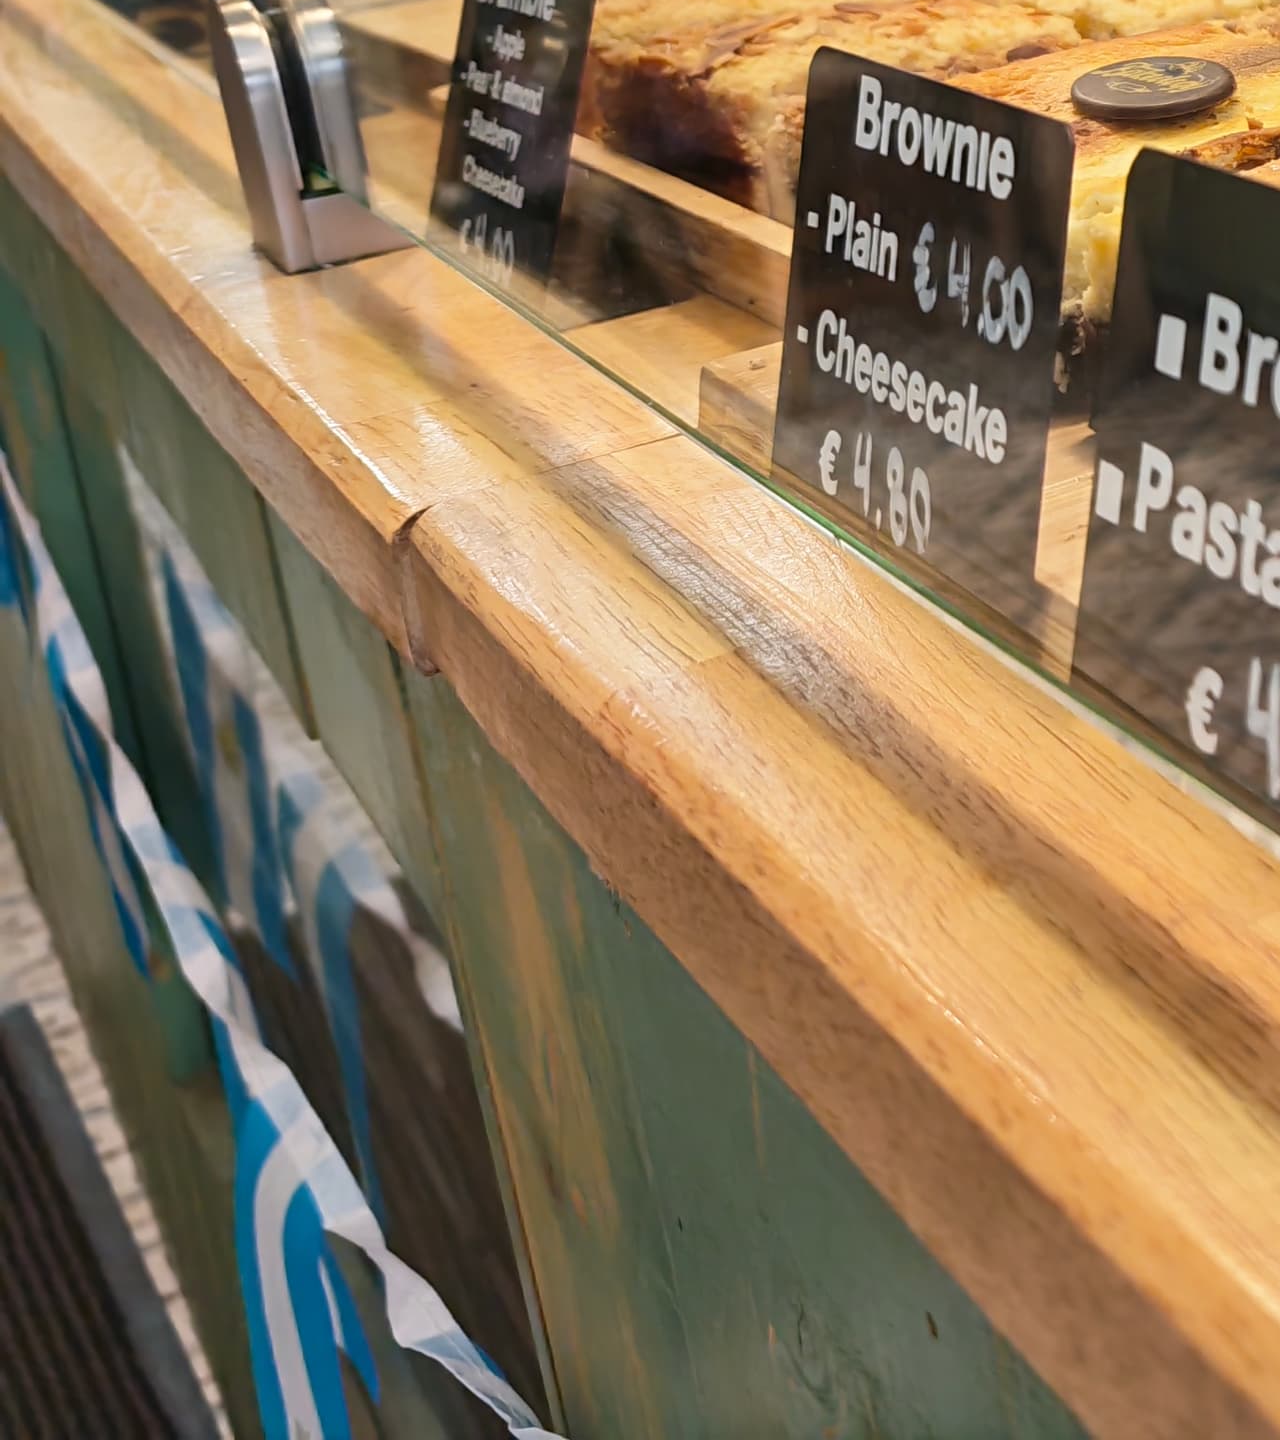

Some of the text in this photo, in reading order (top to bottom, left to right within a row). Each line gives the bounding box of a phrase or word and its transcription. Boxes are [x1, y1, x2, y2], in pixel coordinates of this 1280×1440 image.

[854, 74, 1016, 200] Brownie
[825, 193, 899, 282] Plain
[814, 309, 1008, 465] Cheesecake
